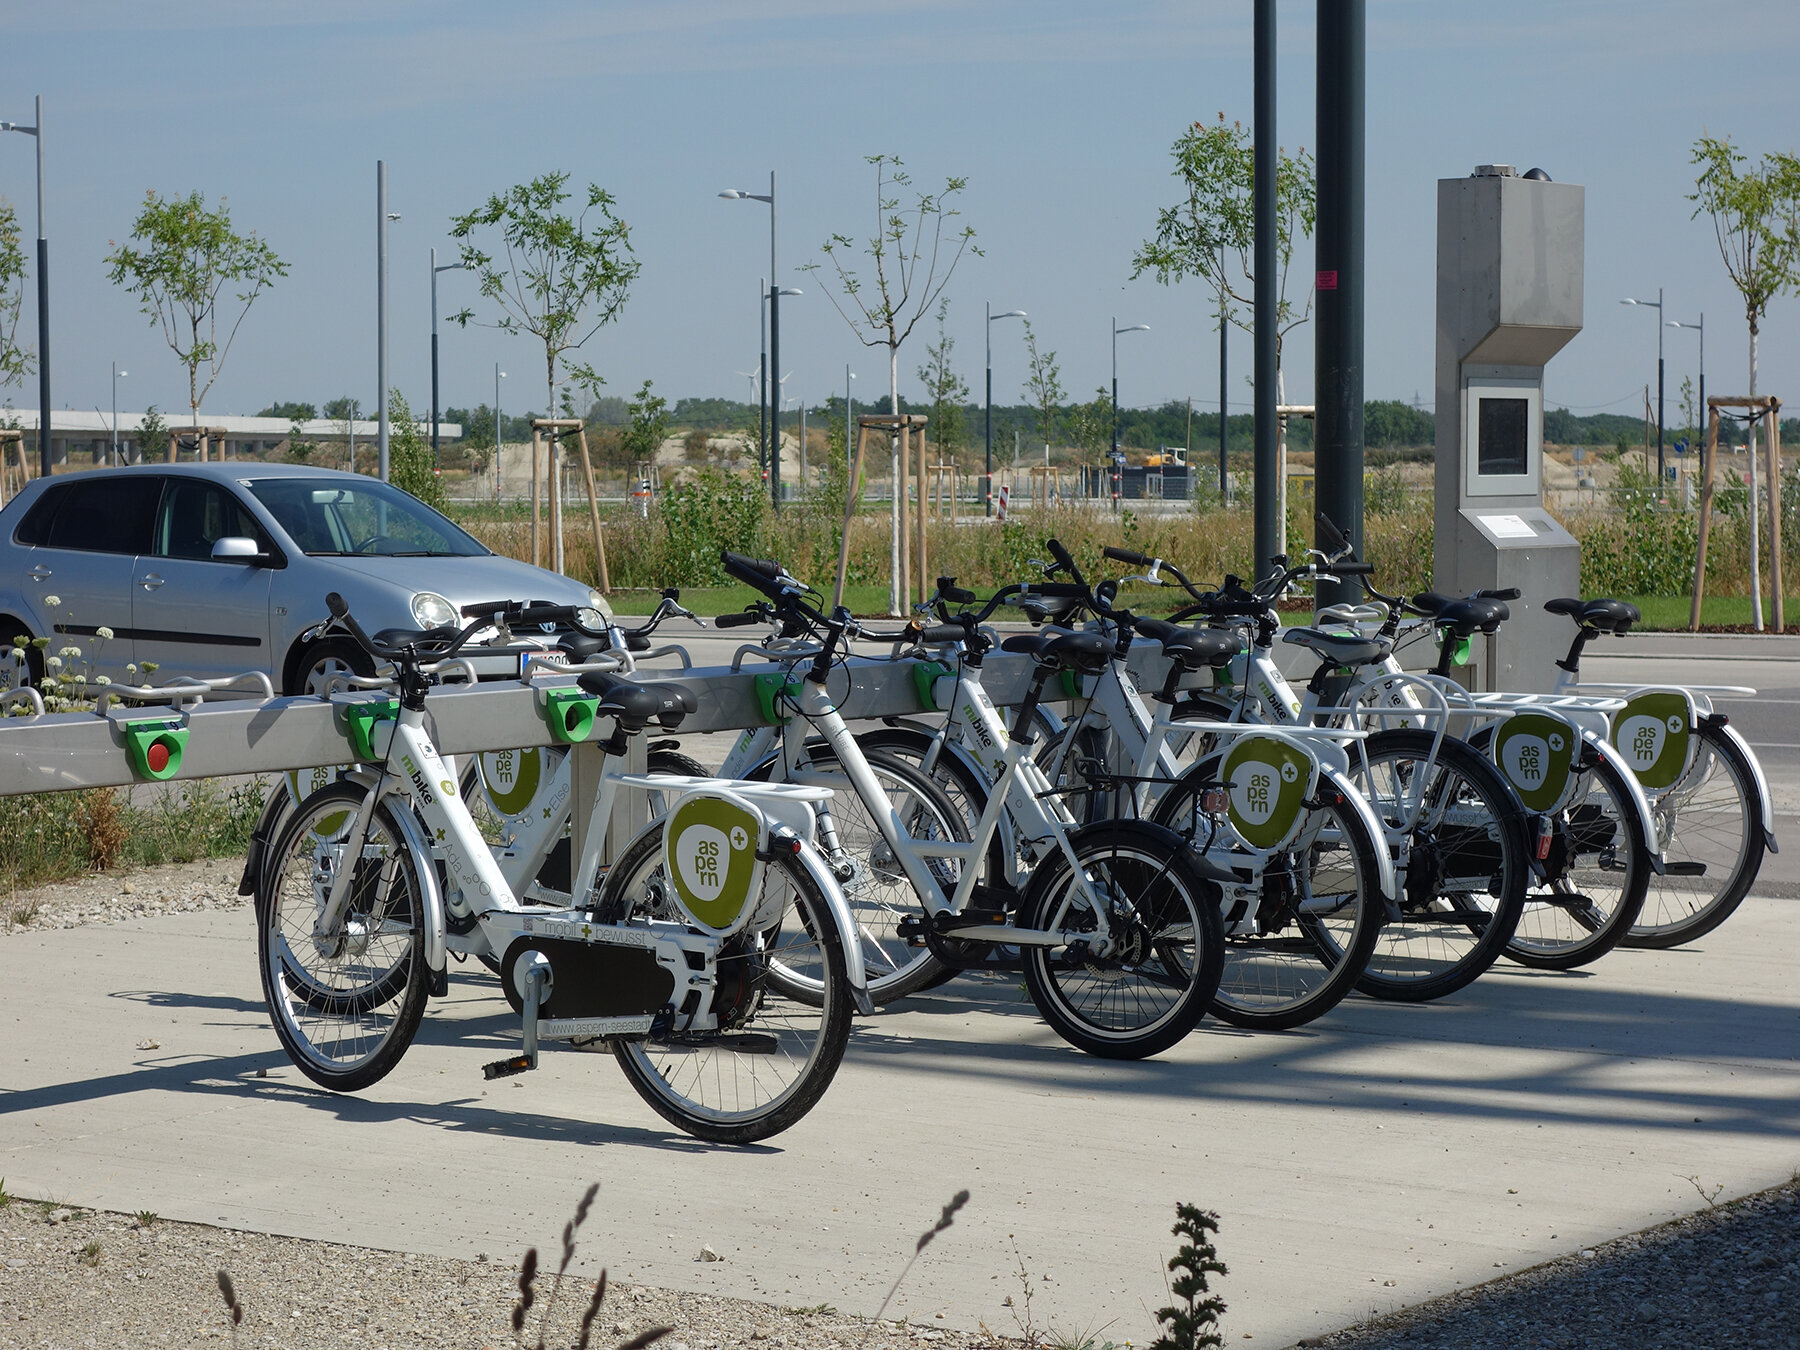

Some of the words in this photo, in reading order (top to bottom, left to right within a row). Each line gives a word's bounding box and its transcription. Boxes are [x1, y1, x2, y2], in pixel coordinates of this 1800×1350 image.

[1637, 726, 1656, 738] as
[1521, 745, 1540, 757] as
[1633, 737, 1653, 752] pe
[498, 750, 513, 760] as
[1637, 749, 1653, 760] rn
[496, 758, 512, 774] pe
[1519, 756, 1539, 771] pe
[499, 772, 513, 783] rn
[1251, 774, 1270, 788] as
[1524, 768, 1541, 780] rn
[1247, 786, 1268, 802] pe
[1251, 800, 1268, 813] rn
[698, 840, 719, 856] as
[442, 843, 462, 873] Ada
[695, 855, 717, 874] pe
[700, 871, 719, 887] rn
[544, 922, 577, 936] mobil
[595, 925, 646, 945] bewusst
